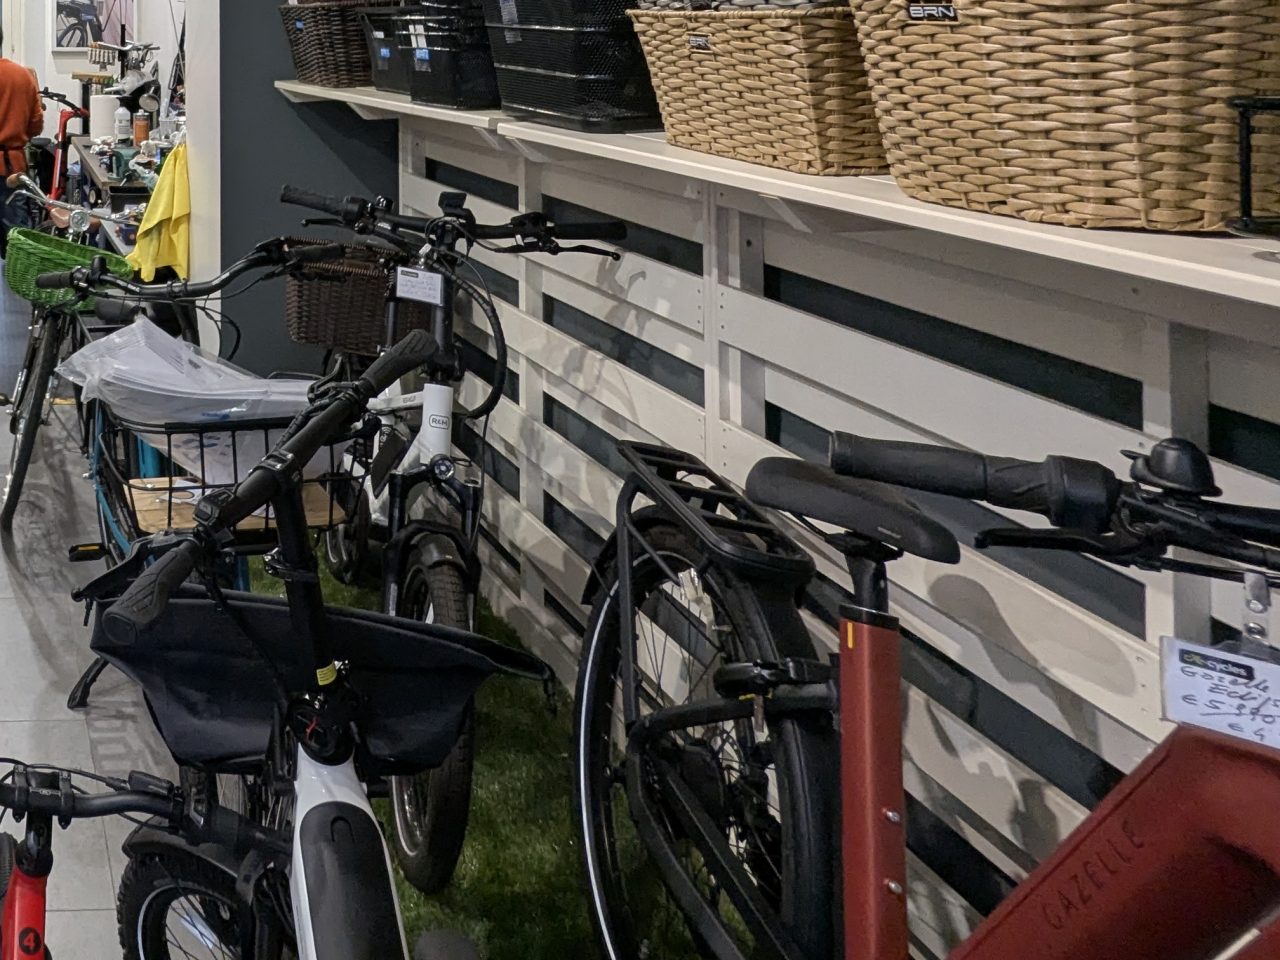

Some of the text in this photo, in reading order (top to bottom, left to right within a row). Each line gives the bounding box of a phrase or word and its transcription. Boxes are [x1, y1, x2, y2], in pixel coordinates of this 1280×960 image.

[910, 5, 955, 18] BRN
[1041, 820, 1144, 930] GAZELLE
[23, 933, 35, 950] 4
